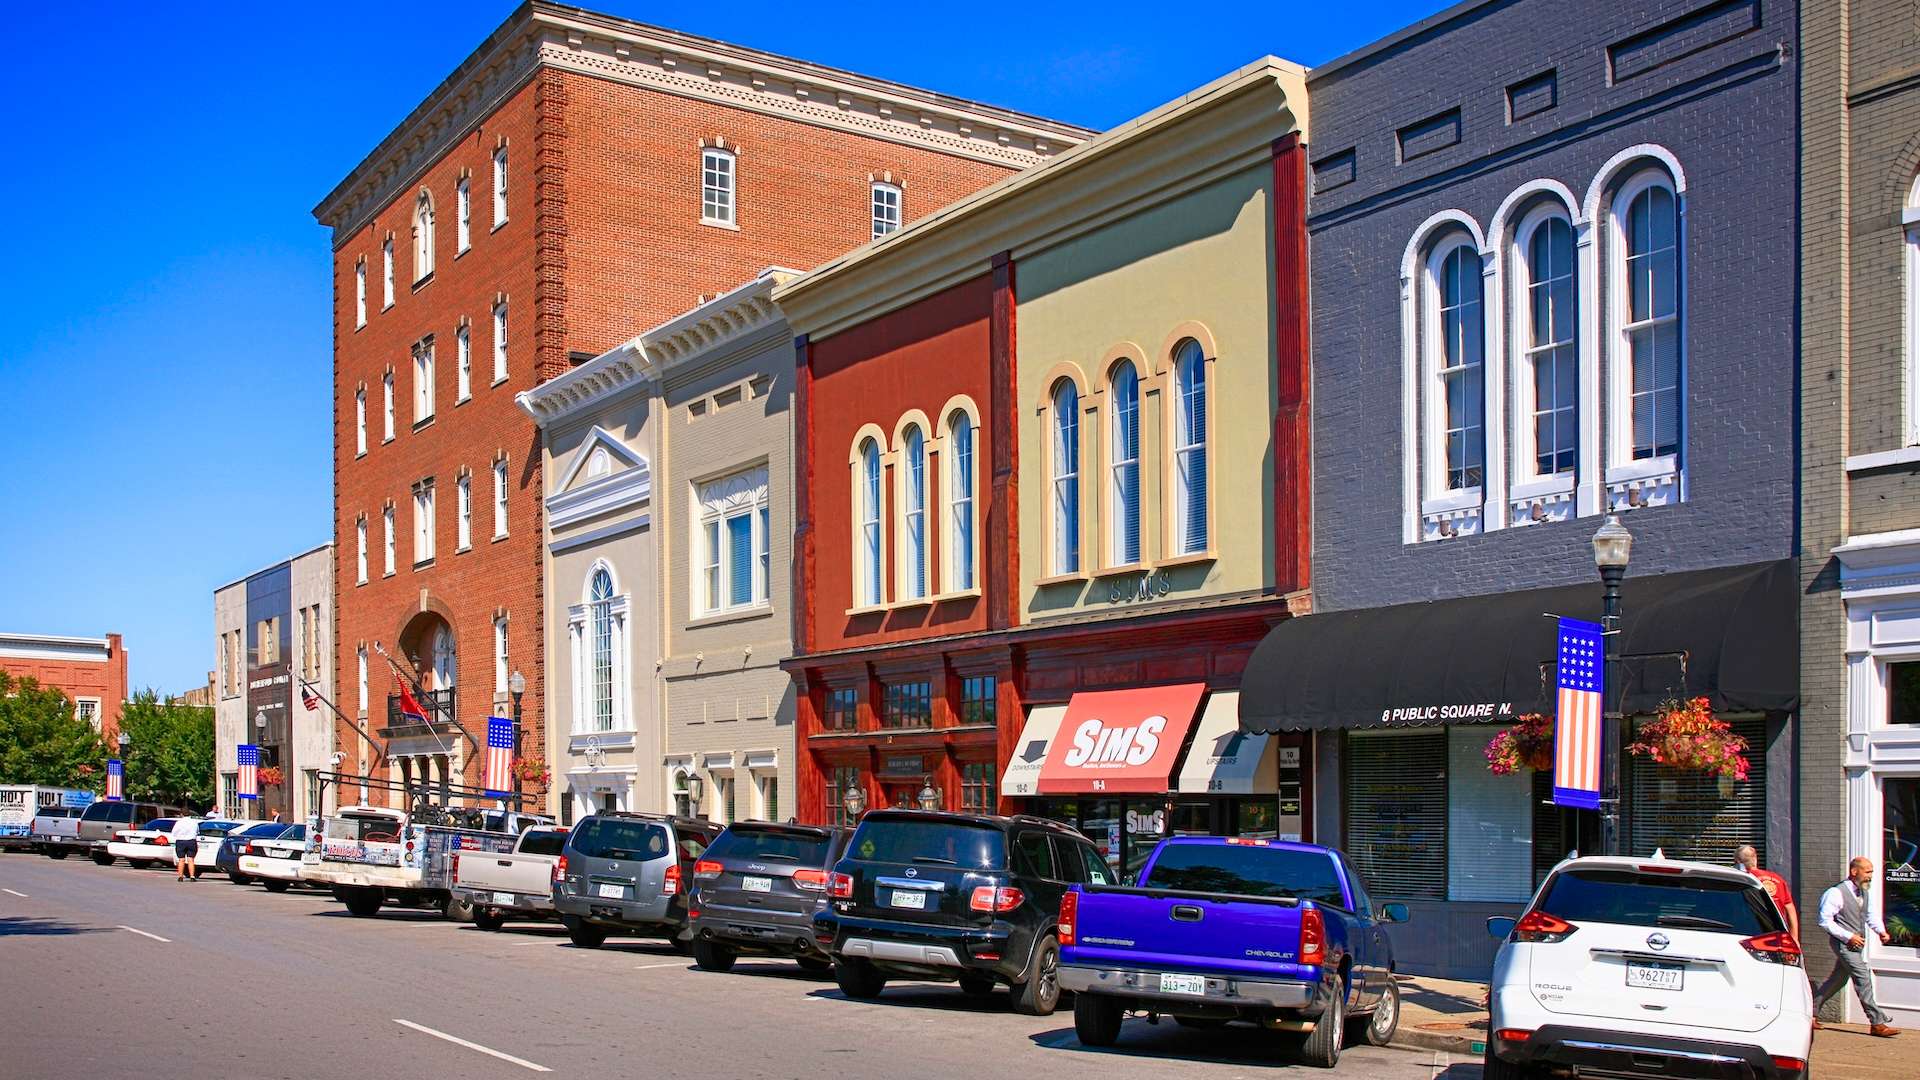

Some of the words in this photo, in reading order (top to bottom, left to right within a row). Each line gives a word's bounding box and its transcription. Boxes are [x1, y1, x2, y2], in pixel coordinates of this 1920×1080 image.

[1110, 572, 1170, 601] SIMS
[1382, 709, 1390, 722] 8
[1392, 706, 1438, 721] PUBLIC
[1440, 703, 1495, 719] SQUARE
[1498, 702, 1512, 715] N.
[1064, 715, 1168, 767] SIMS
[1286, 751, 1294, 759] 10
[1092, 779, 1106, 791] 10-A
[1208, 779, 1223, 791] 10-B
[1126, 809, 1165, 834] SIMS
[1245, 949, 1295, 959] CHEVROLET
[1535, 983, 1573, 991] ROGUE
